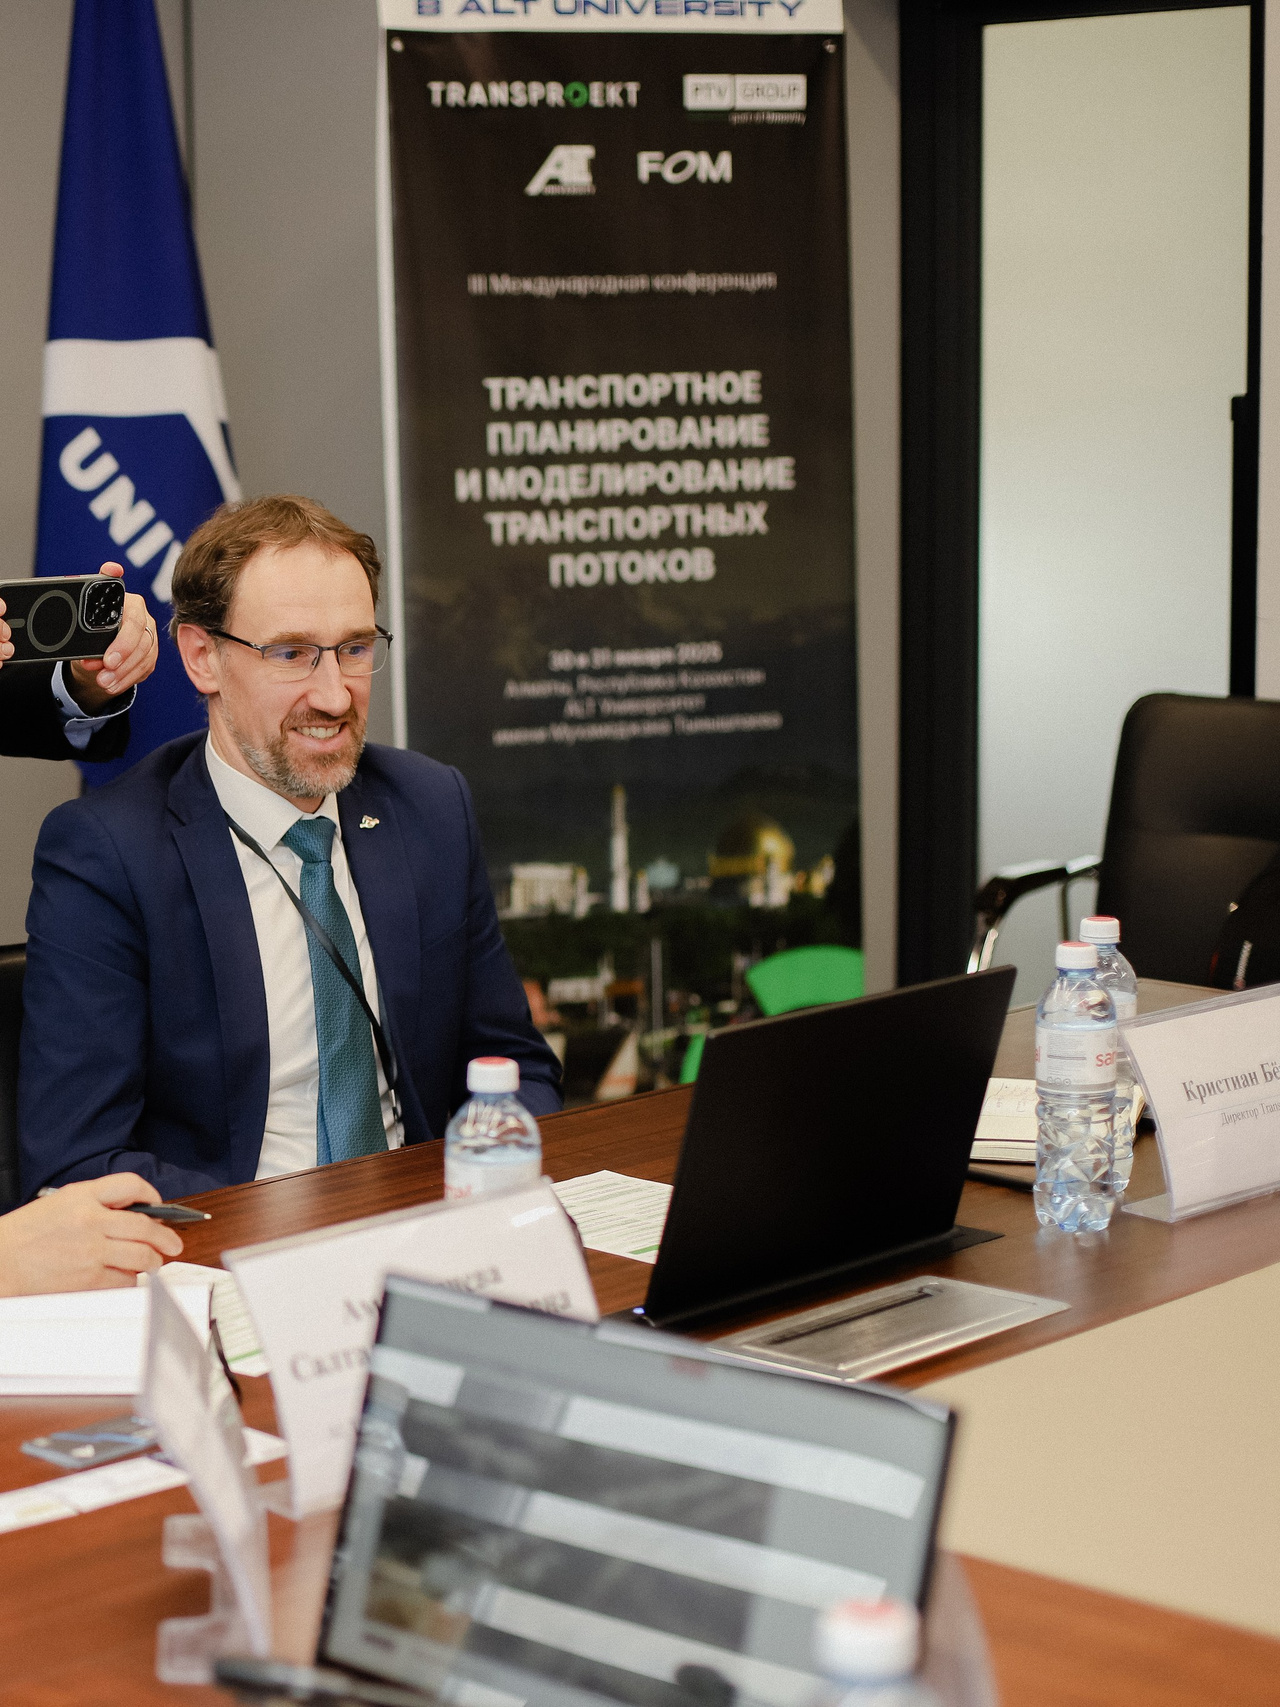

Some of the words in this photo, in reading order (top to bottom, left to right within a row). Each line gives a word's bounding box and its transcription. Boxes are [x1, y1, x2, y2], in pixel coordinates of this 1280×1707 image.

[427, 80, 641, 108] TRANSPROEKT
[636, 149, 733, 185] FOM
[483, 370, 762, 412] ТРАНСПОРТНОЕ
[486, 413, 770, 456] ПЛАНИРОВАНИЕ
[455, 467, 482, 502] И
[486, 456, 796, 506] МОДЕЛИРОВАНИЕ
[484, 500, 770, 547] ТРАНСПОРТНЫХ
[548, 546, 717, 589] ПОТОКОВ
[1182, 1071, 1260, 1105] Кристиан
[1260, 1061, 1280, 1084] Бё
[1221, 1107, 1259, 1126] Директор
